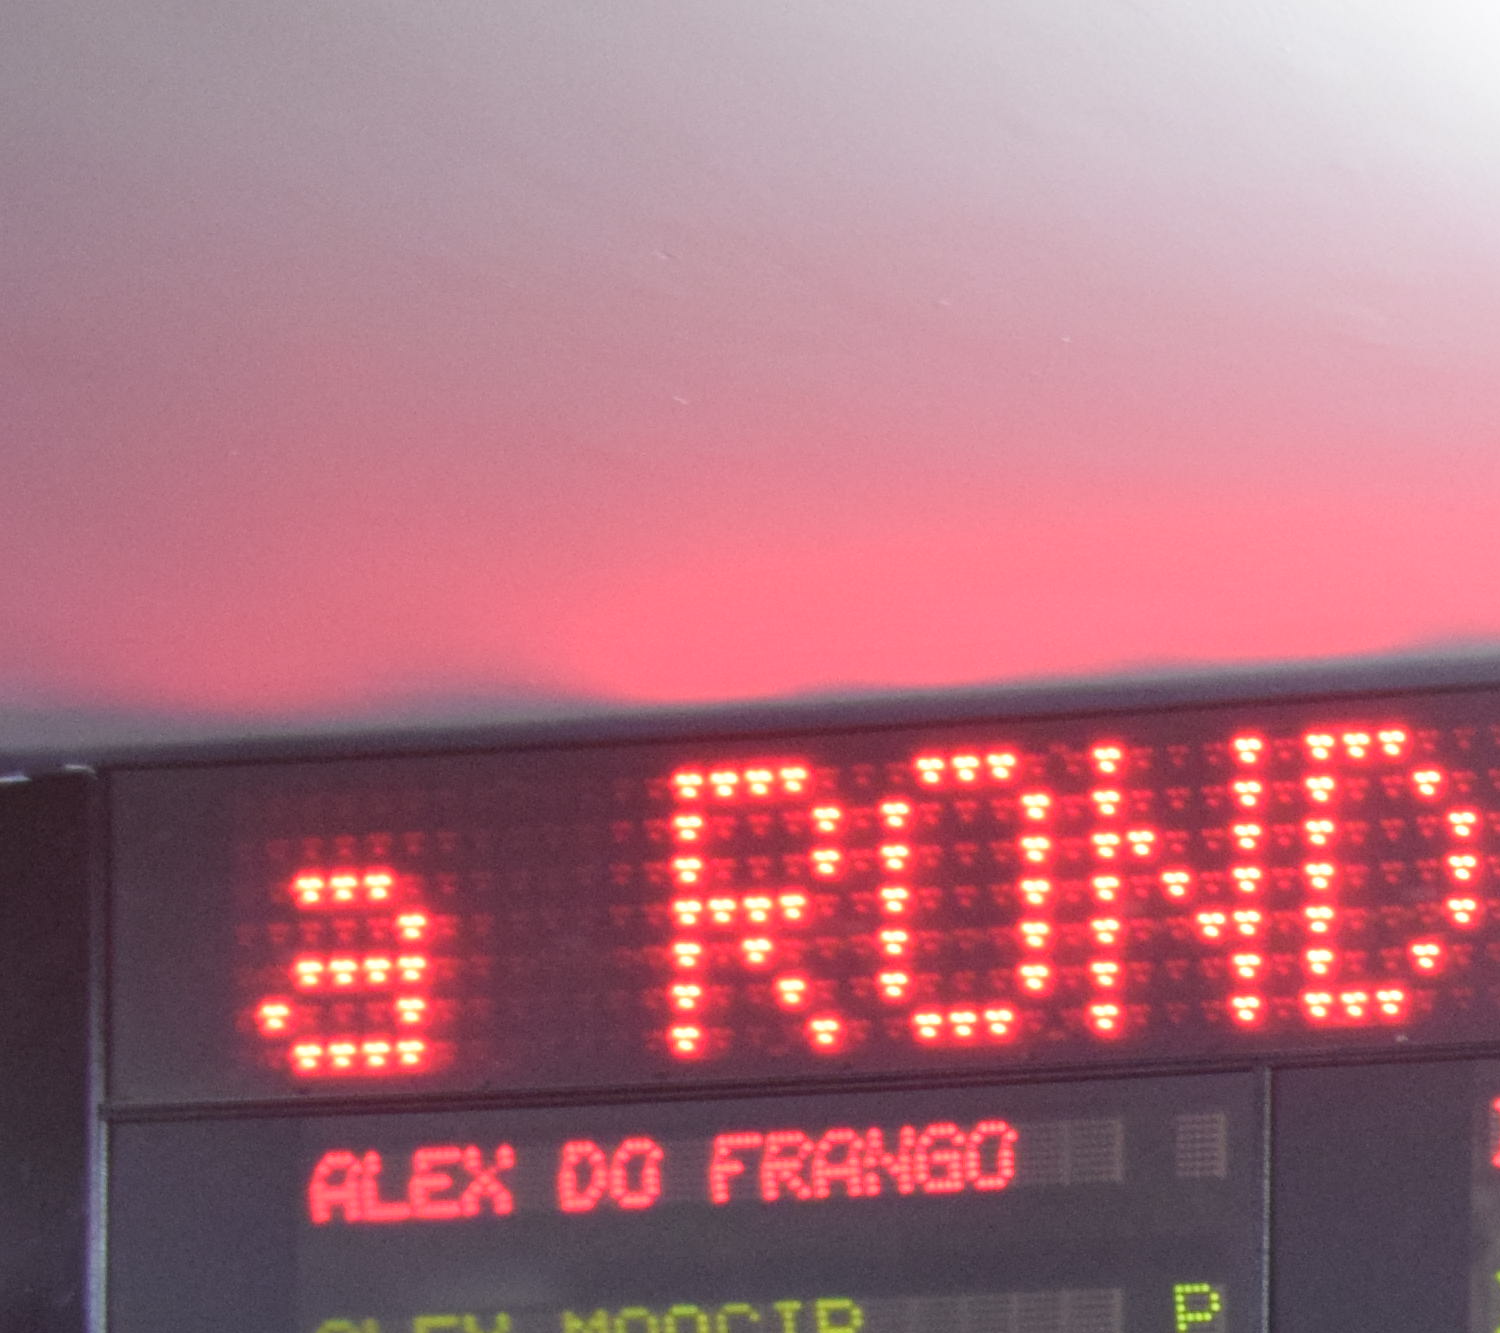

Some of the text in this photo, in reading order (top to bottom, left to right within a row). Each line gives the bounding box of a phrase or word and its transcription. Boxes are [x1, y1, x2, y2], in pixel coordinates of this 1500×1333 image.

[307, 1118, 1020, 1225] ALEX DO FRANGO
